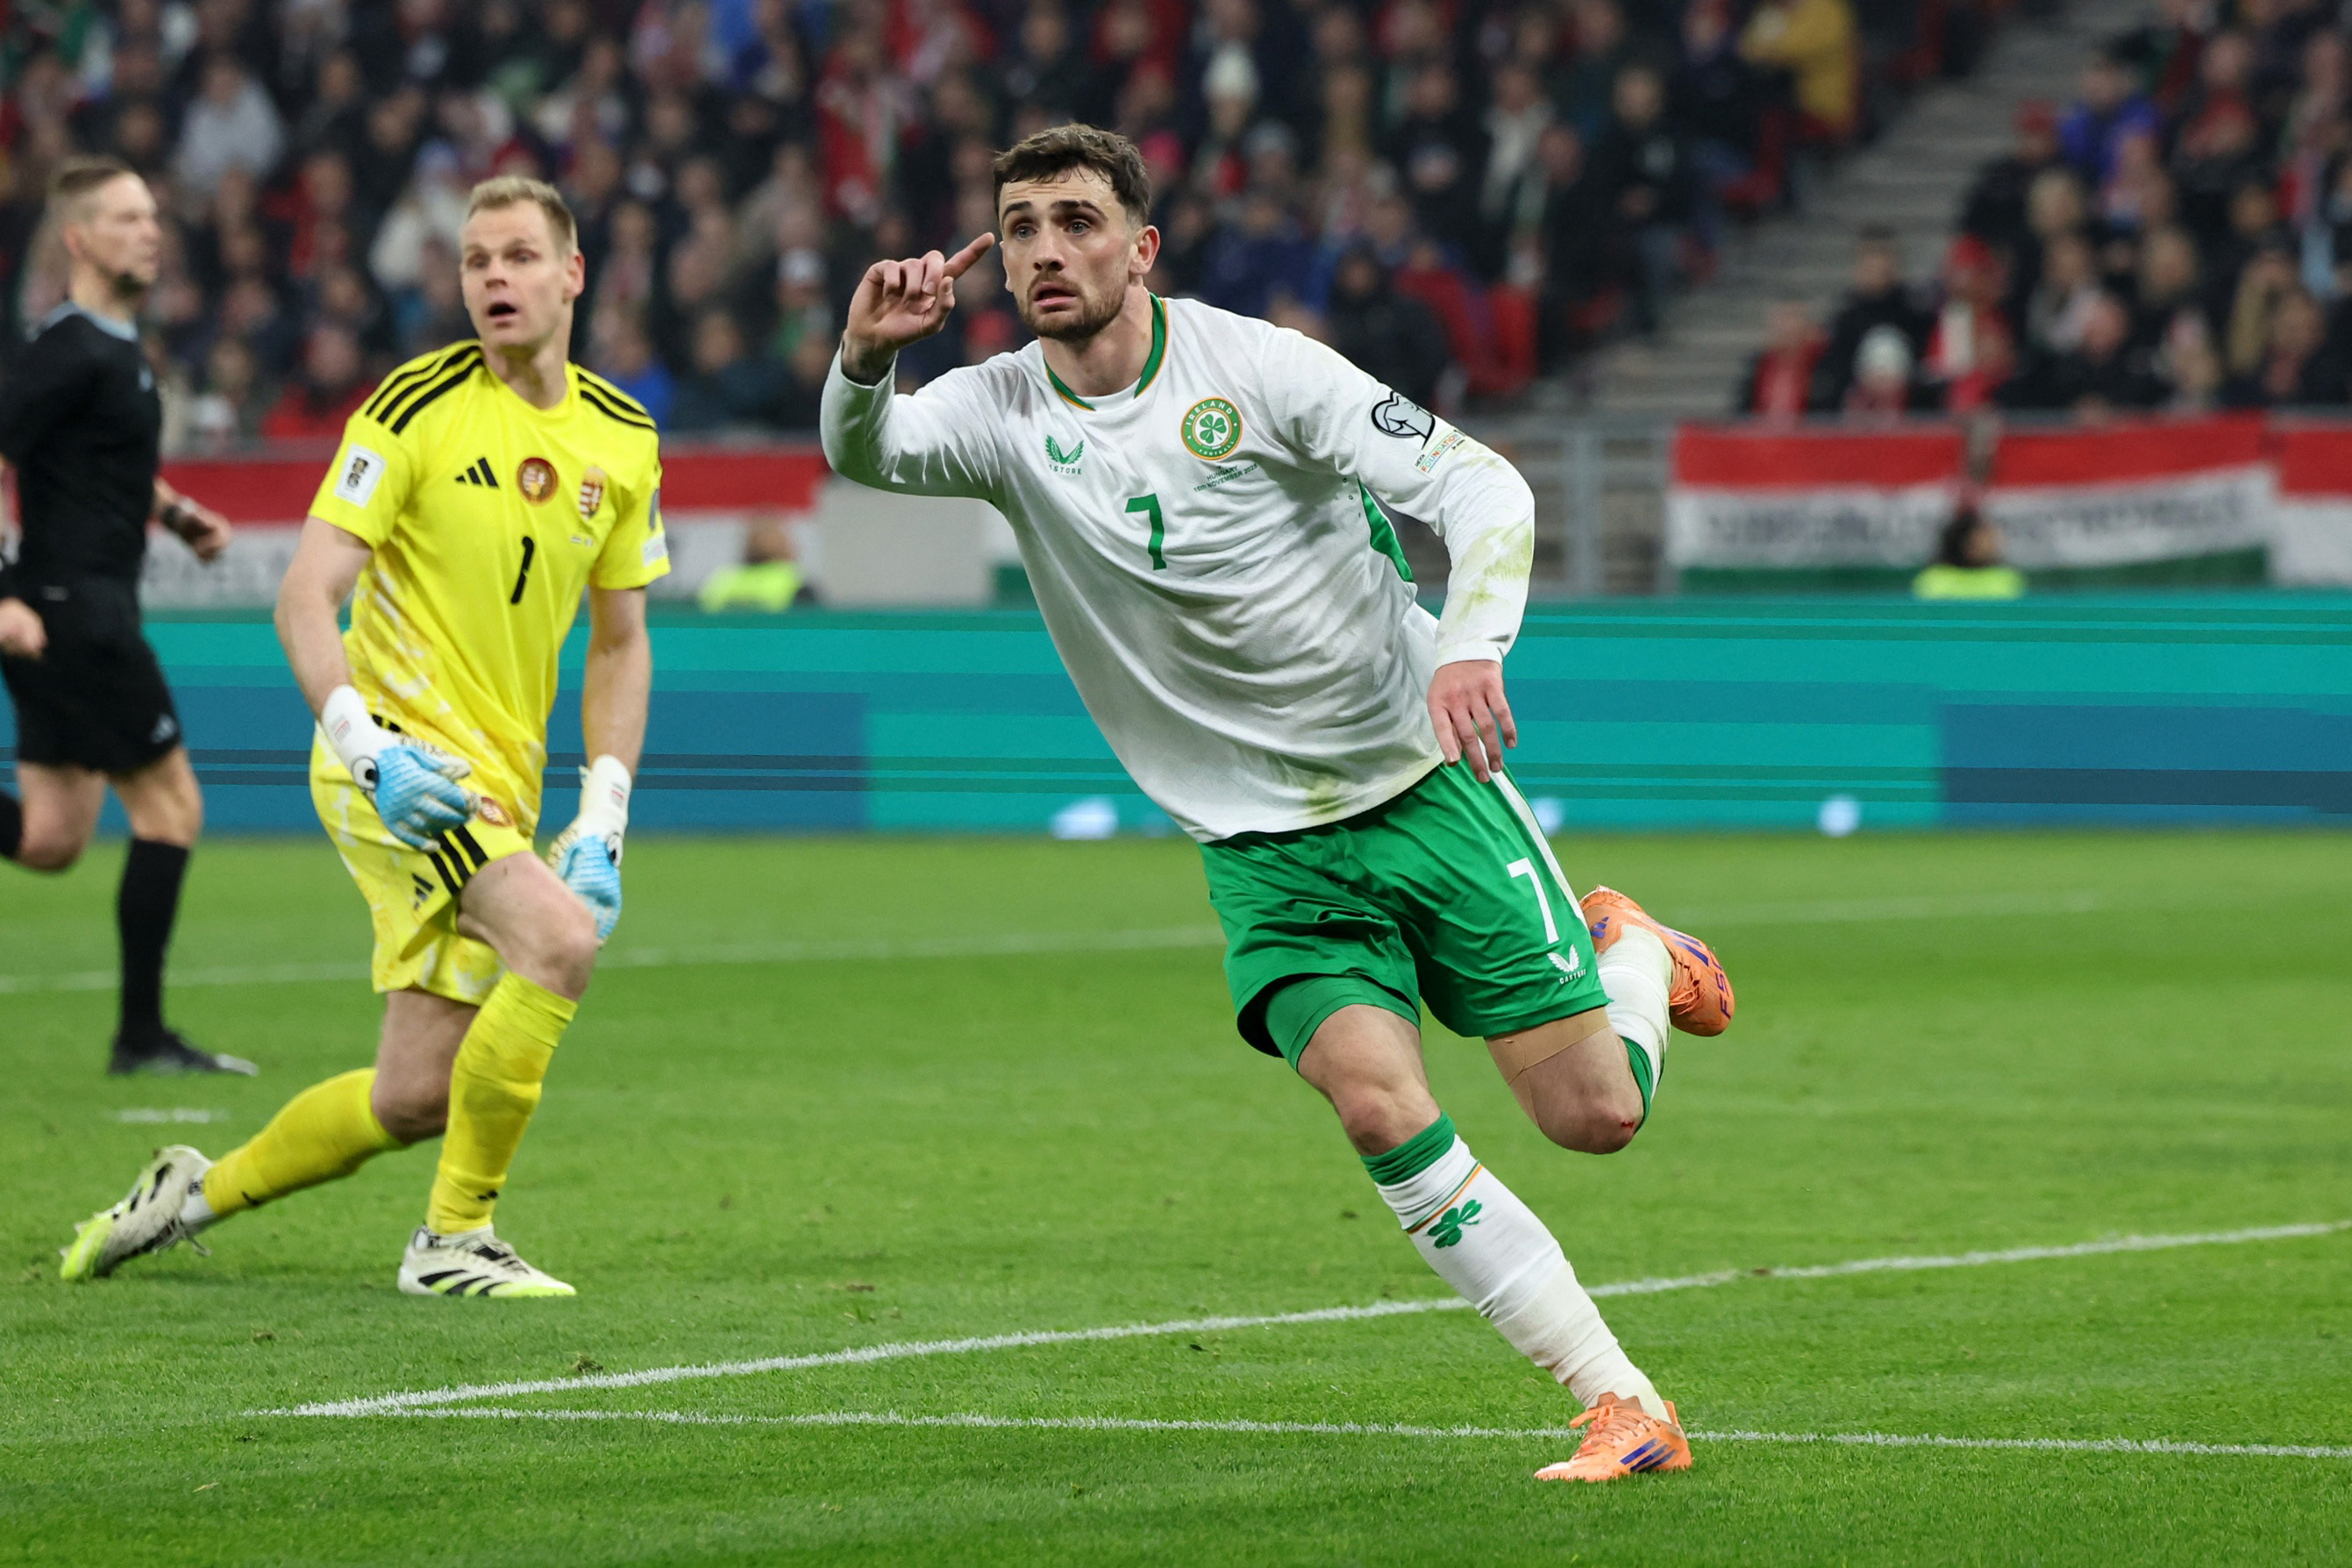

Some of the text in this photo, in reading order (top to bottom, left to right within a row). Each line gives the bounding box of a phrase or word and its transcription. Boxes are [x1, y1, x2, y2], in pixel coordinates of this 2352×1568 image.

[1186, 401, 1233, 425] IRELAND
[1199, 441, 1235, 456] FOOTBALL
[1207, 465, 1237, 481] HUNGARY
[1207, 470, 1244, 488] NOVEMBER
[1125, 494, 1167, 571] 7
[510, 536, 534, 605] 1
[1506, 857, 1560, 944] 7
